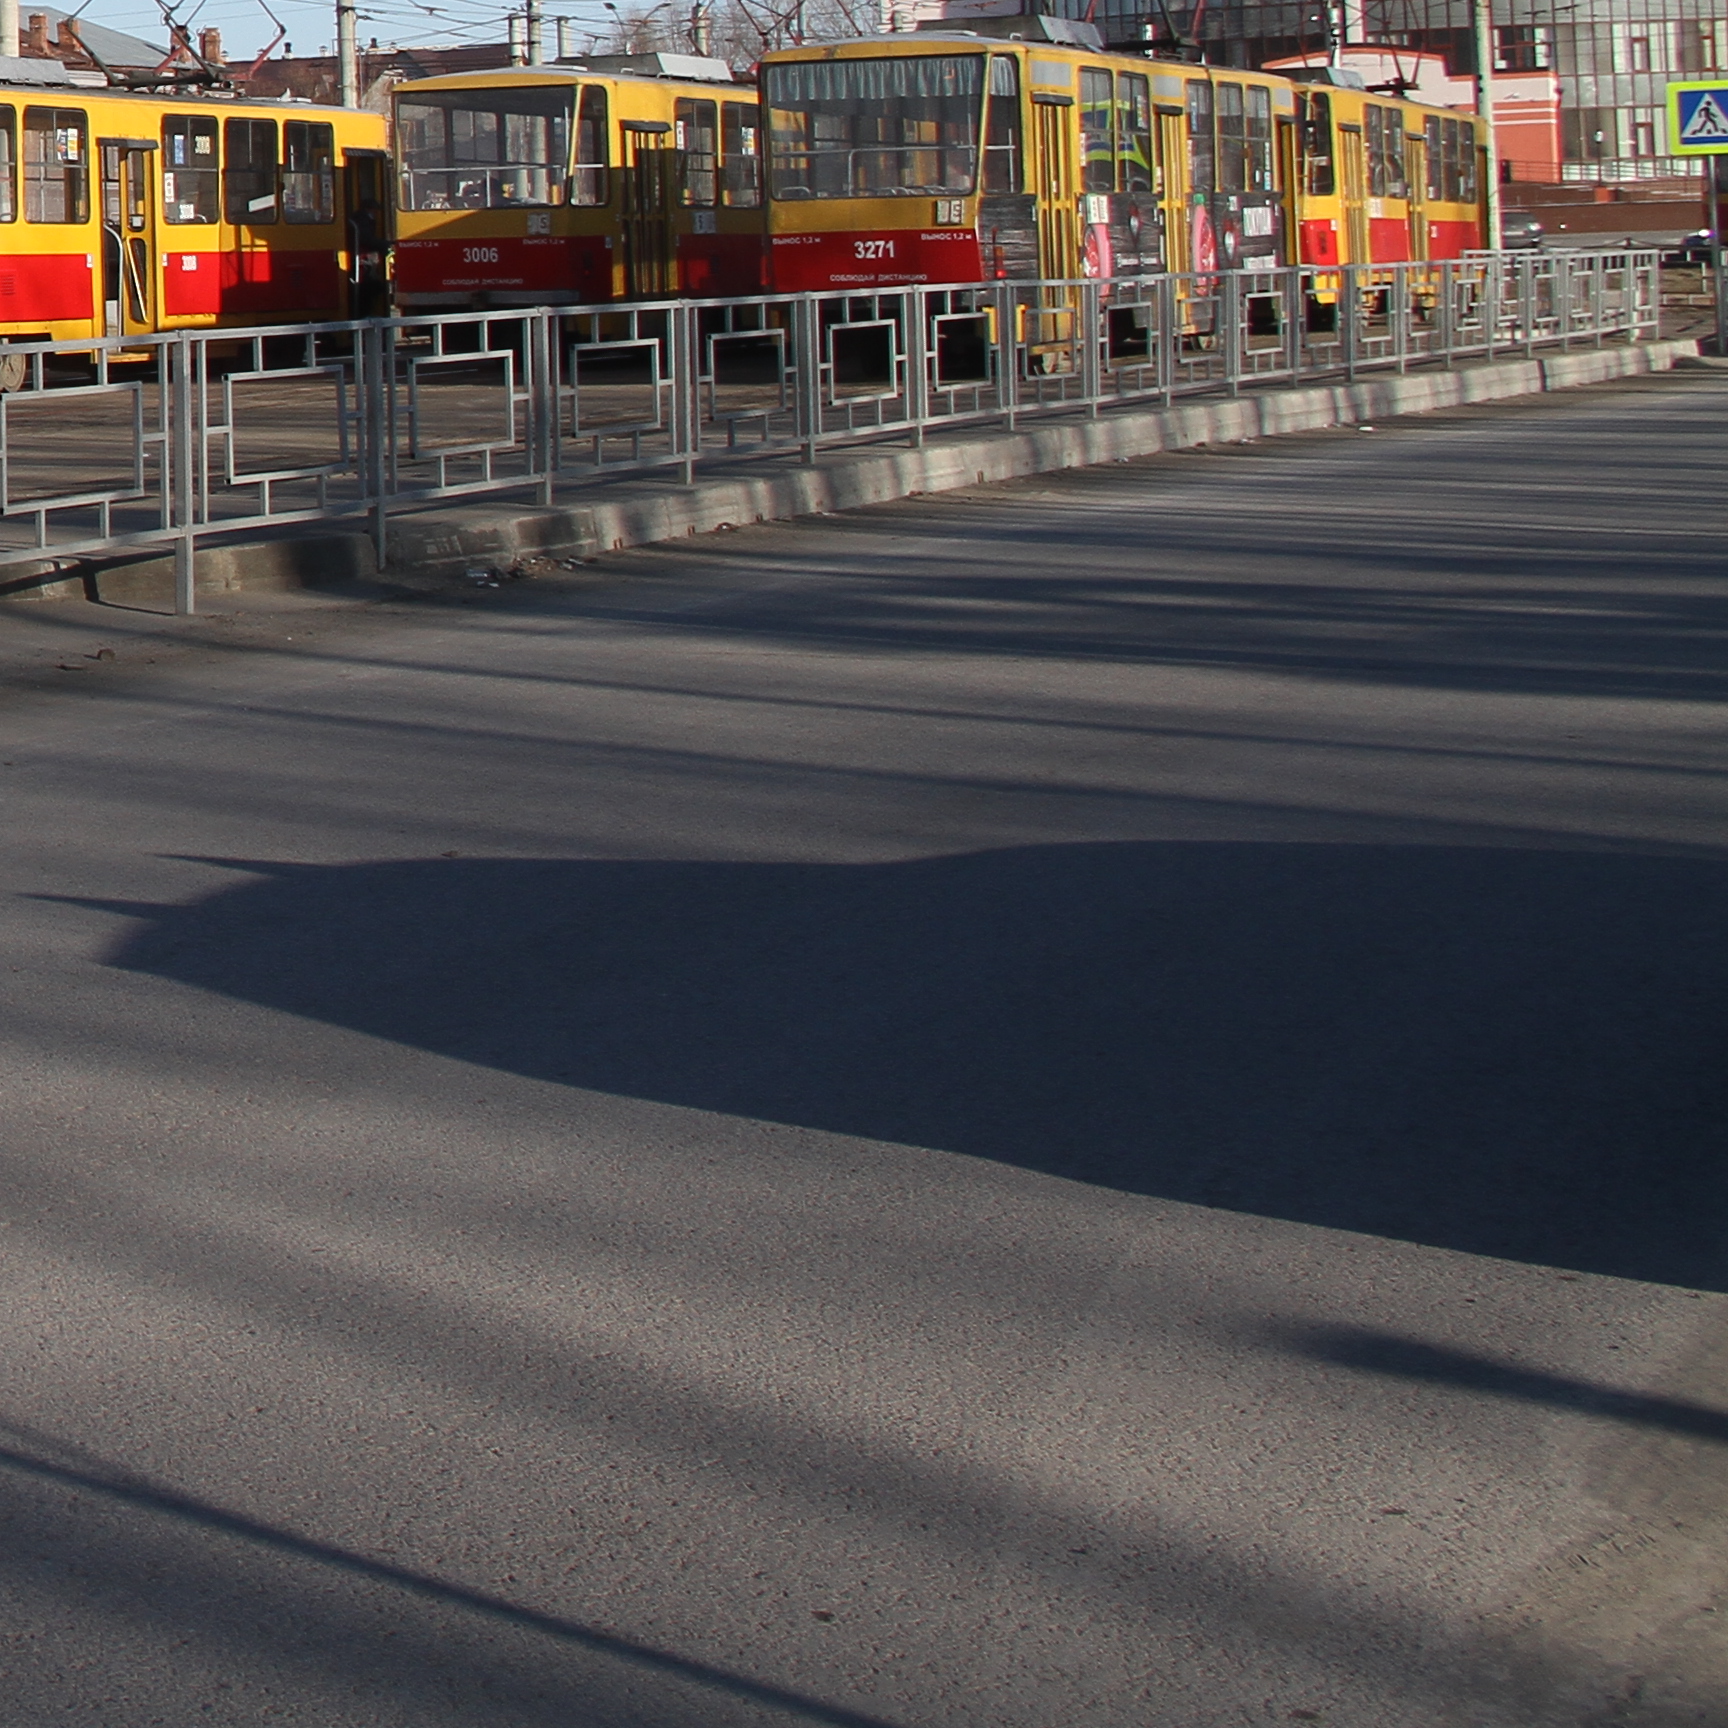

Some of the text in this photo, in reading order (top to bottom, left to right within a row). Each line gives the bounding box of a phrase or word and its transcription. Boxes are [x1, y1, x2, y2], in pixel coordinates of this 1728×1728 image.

[772, 237, 801, 245] ВЫНОС
[921, 233, 952, 241] ВЫНОС
[854, 240, 895, 259] 3271
[463, 247, 499, 263] 3006
[830, 274, 928, 282] СОБЛЮДАЙ ДИСТАНЦИЮ
